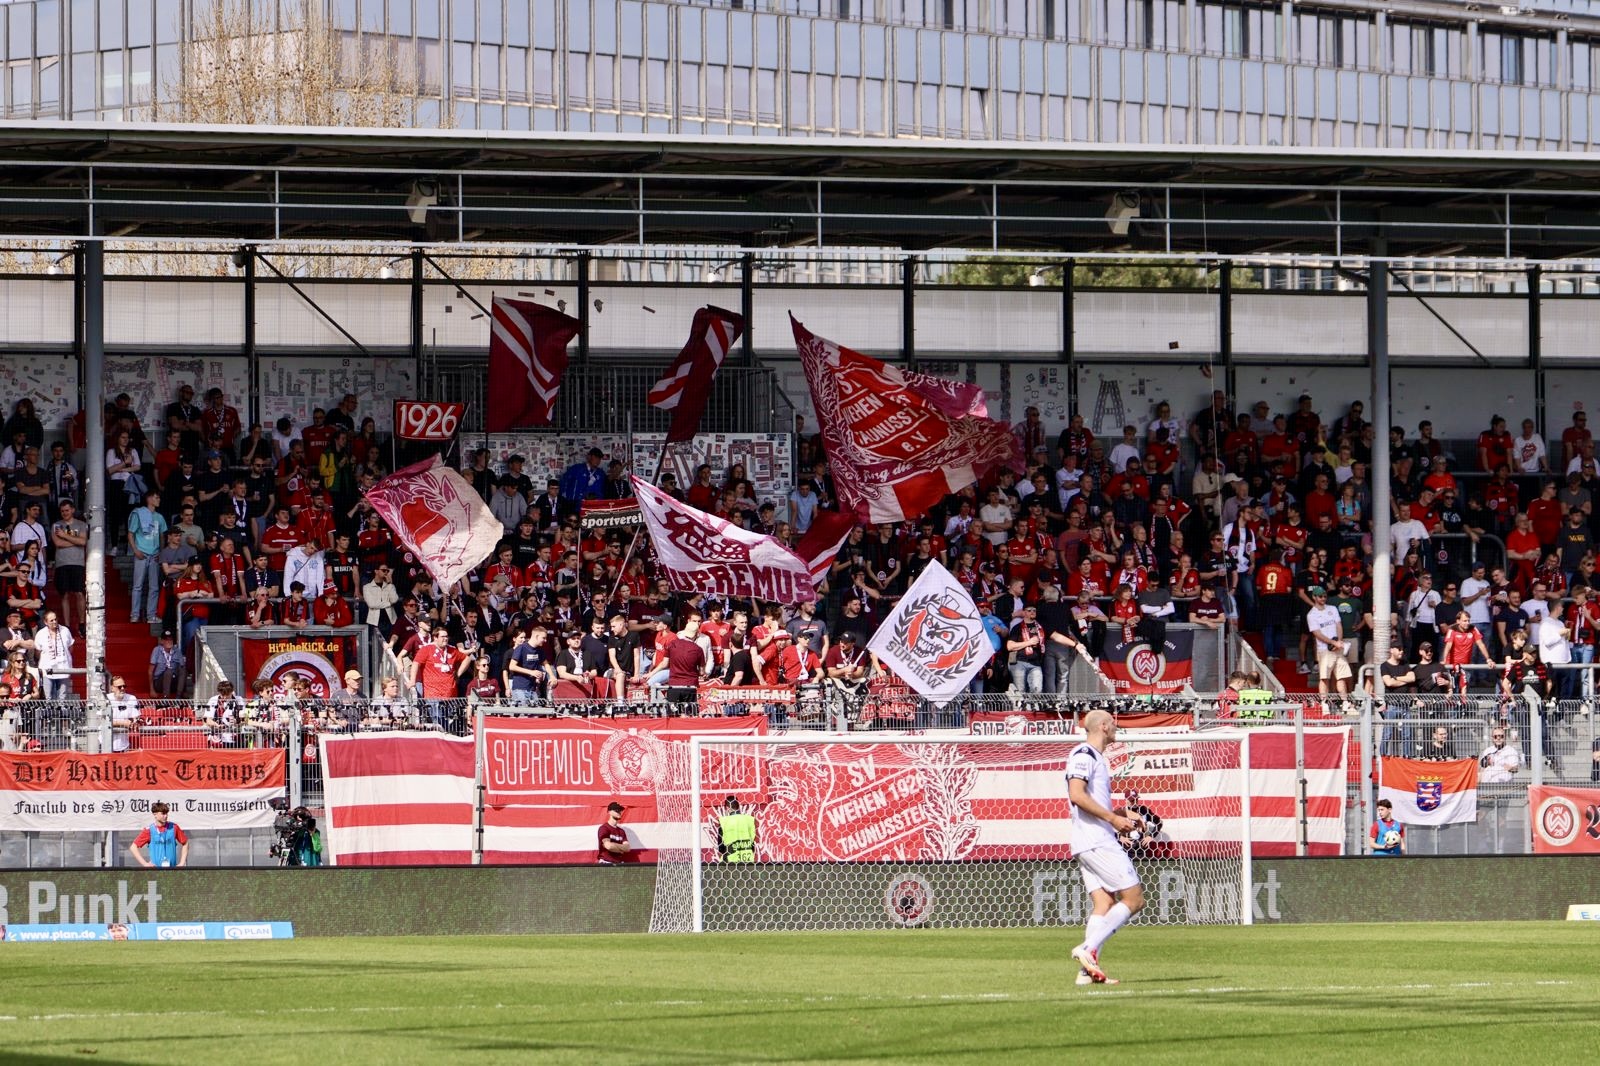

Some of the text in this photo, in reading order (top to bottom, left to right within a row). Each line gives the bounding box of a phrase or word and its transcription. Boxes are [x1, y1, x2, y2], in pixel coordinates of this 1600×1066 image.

[400, 404, 457, 437] 1926
[663, 563, 817, 606] UPREMUS
[1266, 572, 1278, 591] 9
[886, 640, 943, 690] SUPCREW
[12, 761, 55, 782] Die
[494, 739, 594, 785] SUPREMUS
[847, 753, 876, 787] SV
[1144, 757, 1189, 770] ALLER
[13, 800, 67, 815] Fanclub
[72, 800, 95, 813] des
[185, 797, 267, 812] Taunusstein
[826, 790, 888, 829] WEHEN
[28, 880, 163, 924] Punkt
[20, 930, 96, 942] www.plan.de
[176, 927, 203, 937] PLAN
[243, 926, 271, 937] PLAN
